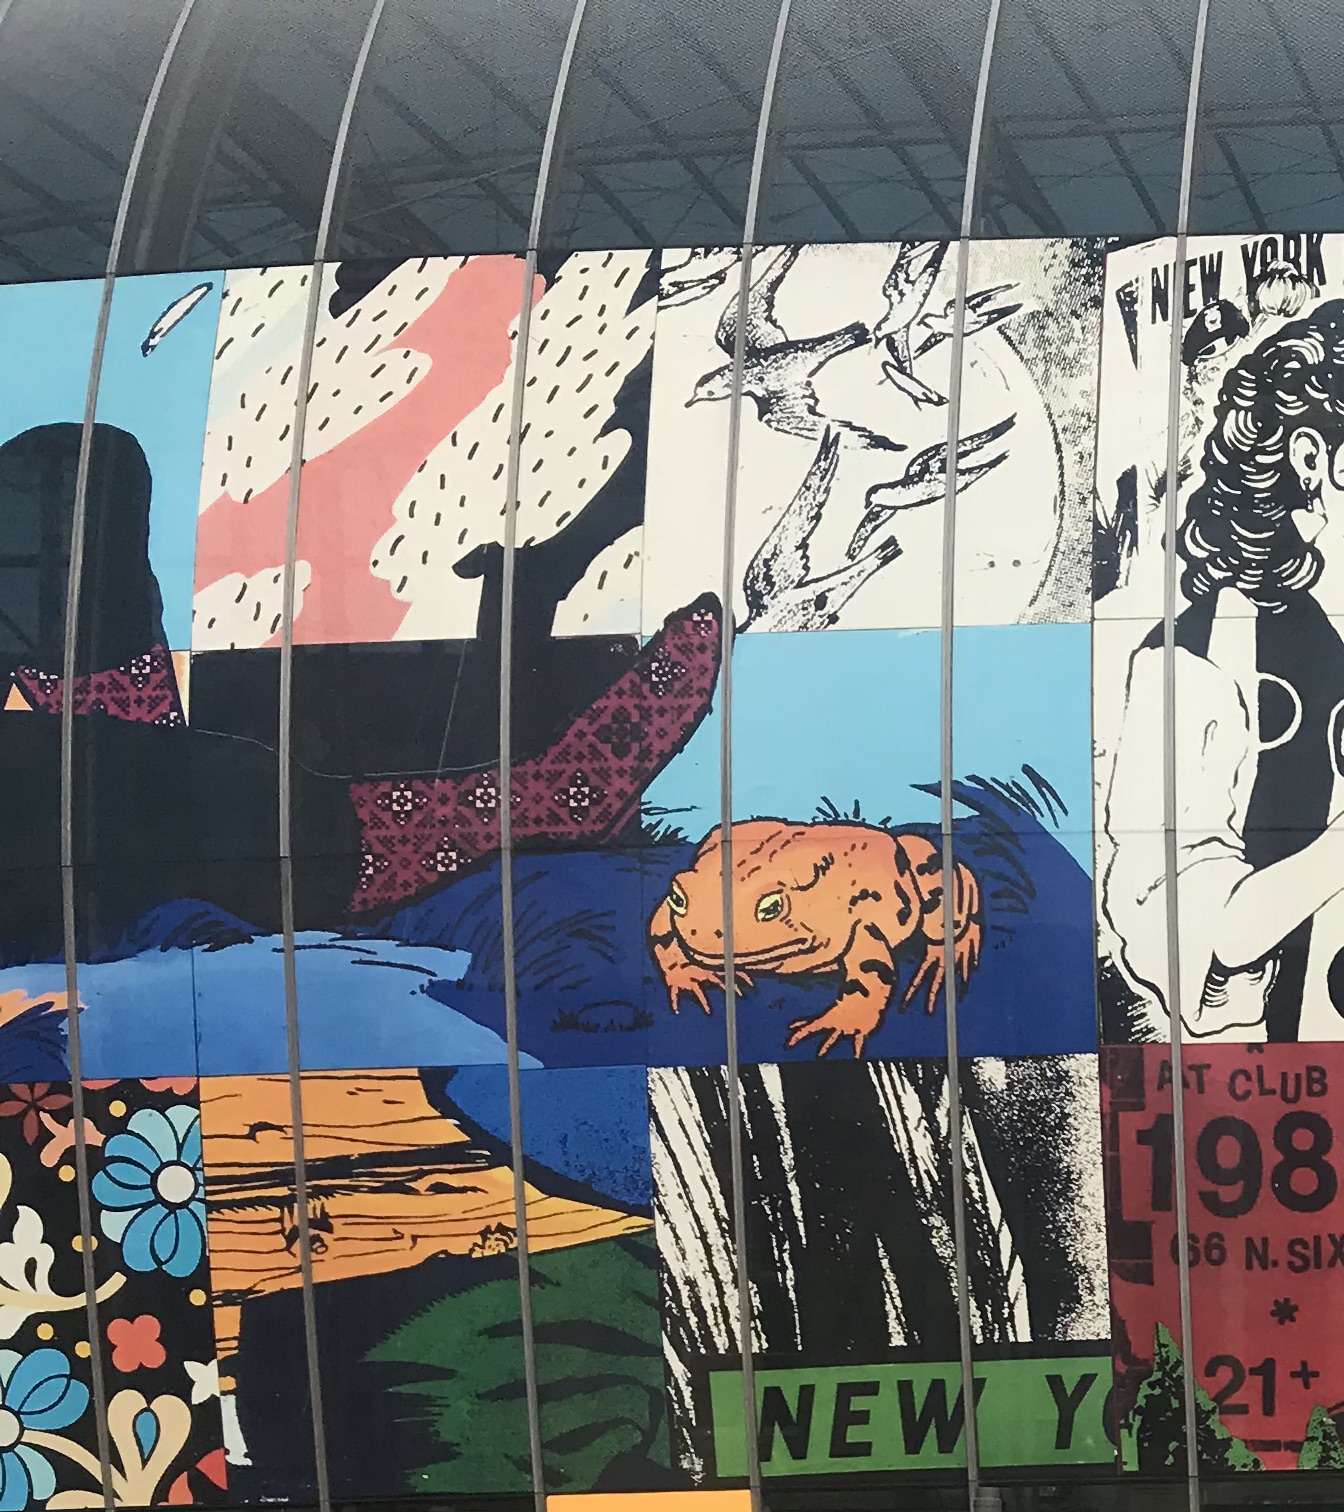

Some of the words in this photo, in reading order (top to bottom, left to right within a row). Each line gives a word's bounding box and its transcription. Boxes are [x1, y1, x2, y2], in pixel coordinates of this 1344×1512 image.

[1151, 250, 1224, 325] NEW
[1227, 1064, 1328, 1103] CLUB
[760, 1376, 988, 1463] NEW
